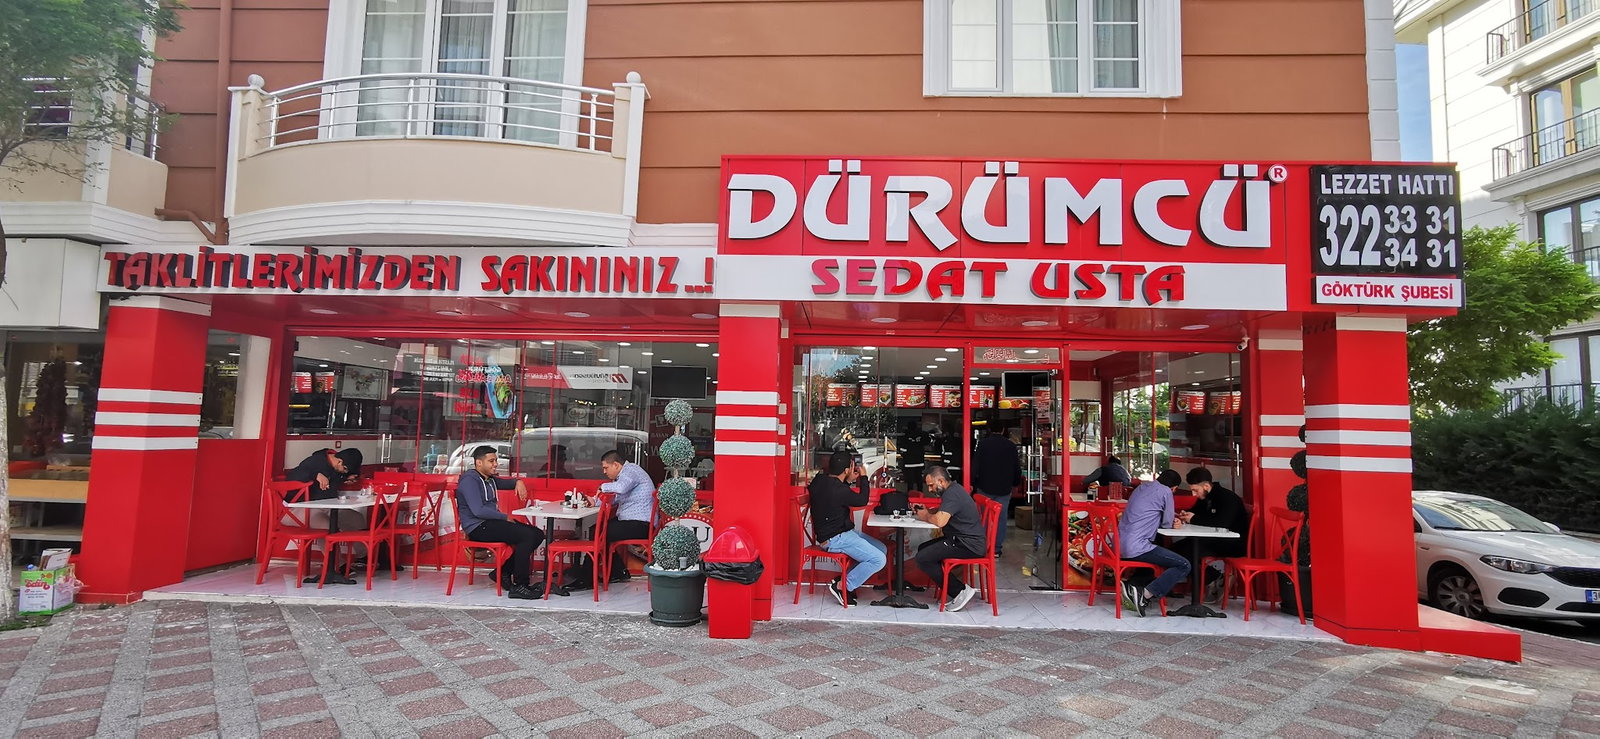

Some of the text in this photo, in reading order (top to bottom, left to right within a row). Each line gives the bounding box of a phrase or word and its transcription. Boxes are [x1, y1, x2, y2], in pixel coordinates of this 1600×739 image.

[1320, 173, 1454, 196] LEZZET HATTI
[727, 159, 1271, 251] DÜRÜMCÜ
[1384, 205, 1456, 235] 33 31
[1319, 204, 1381, 267] 322
[1384, 238, 1457, 268] 34 31
[104, 245, 461, 293] TAKLİTLERİMİZDEN
[811, 258, 1186, 307] SEDAT USTA
[1321, 281, 1454, 302] GÖKTÜRK ŞUBESİ
